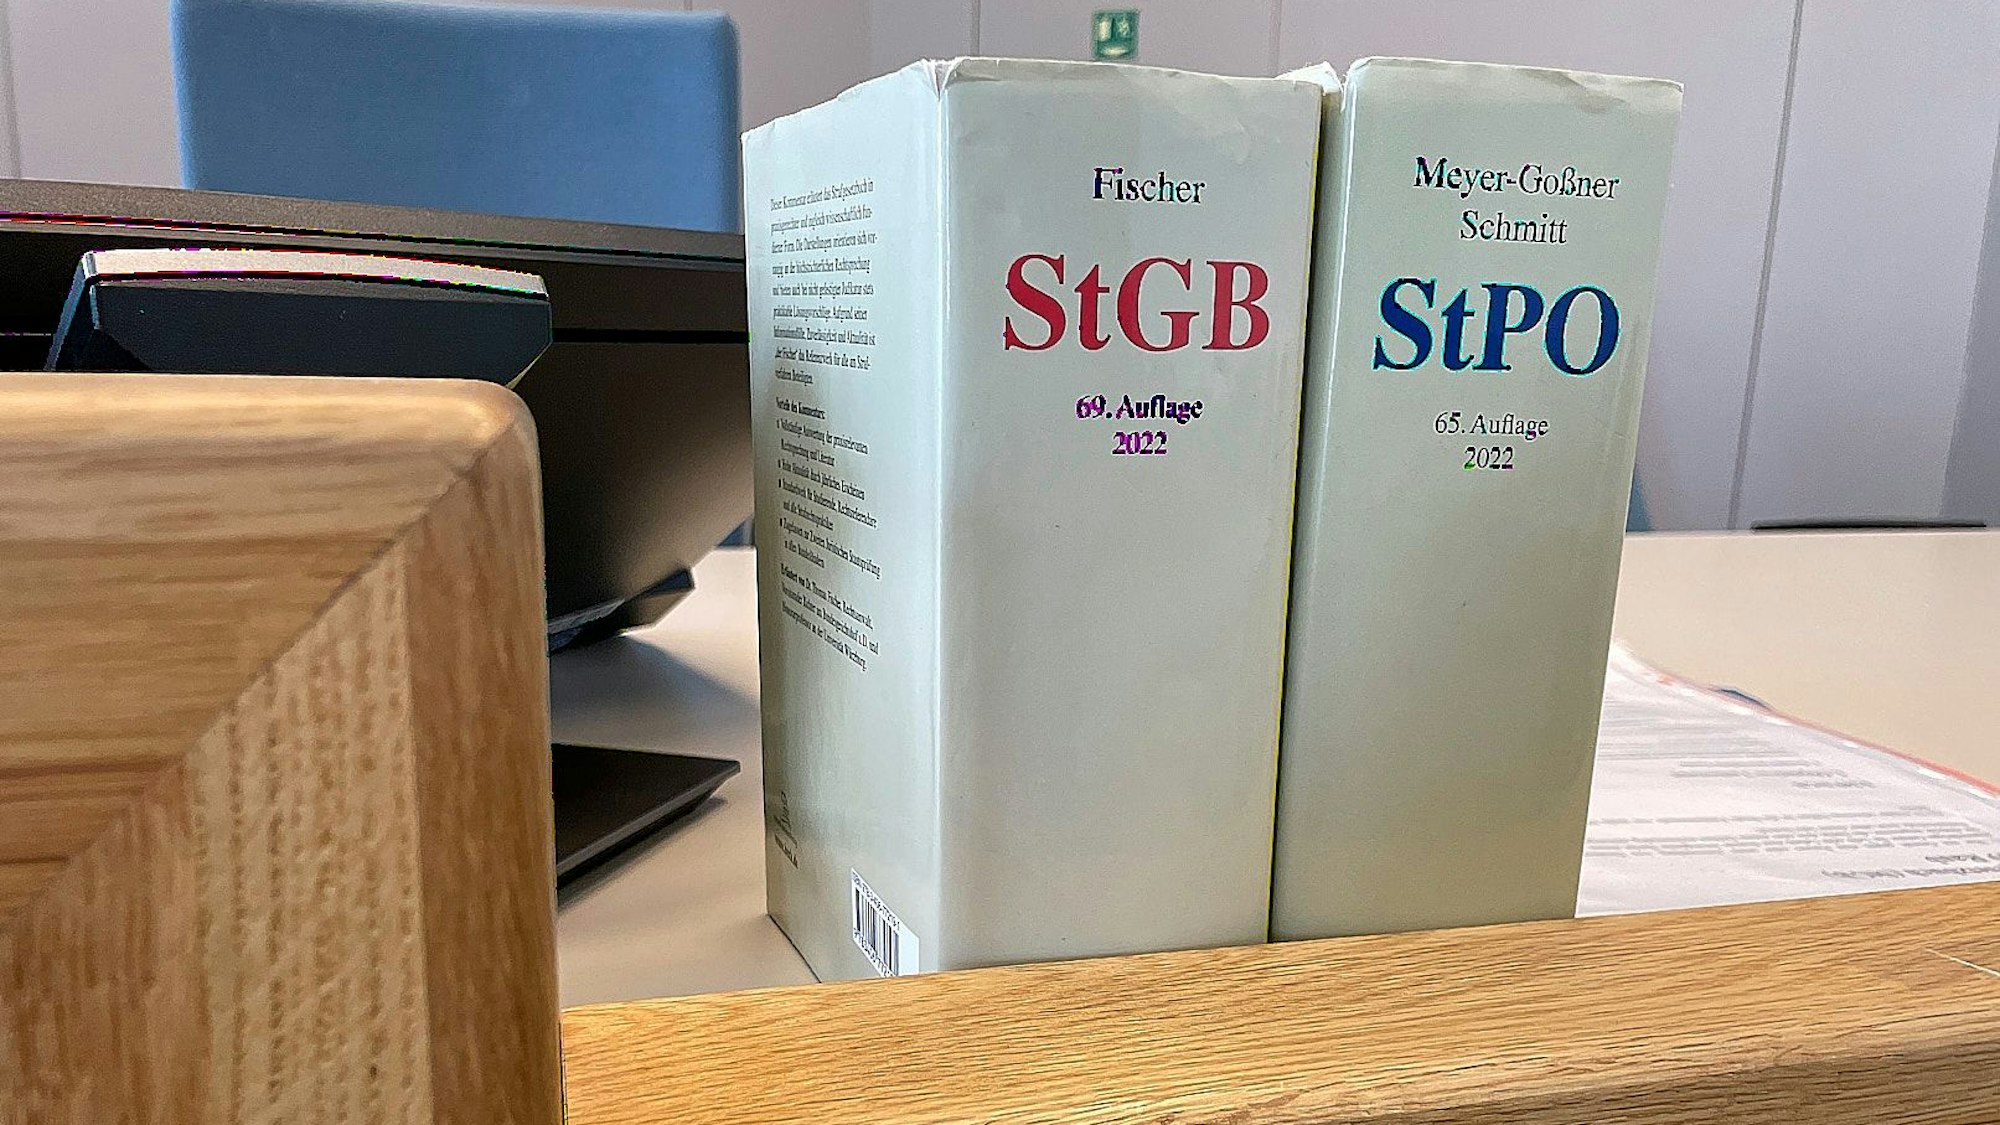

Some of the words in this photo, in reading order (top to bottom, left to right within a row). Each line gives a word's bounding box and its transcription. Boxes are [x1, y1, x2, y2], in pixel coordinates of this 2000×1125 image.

[1093, 167, 1205, 203] Fischer
[1414, 157, 1620, 199] Meyer-Goßner
[1460, 210, 1568, 244] Schmitt
[1004, 254, 1270, 352] StGB
[1372, 277, 1621, 376] StPO
[1075, 395, 1113, 419] 69.
[1116, 394, 1204, 424] Auflage
[1435, 412, 1466, 435] 65.
[1470, 414, 1549, 440] Auflage
[1112, 430, 1168, 455] 2022
[1464, 446, 1514, 470] 2022
